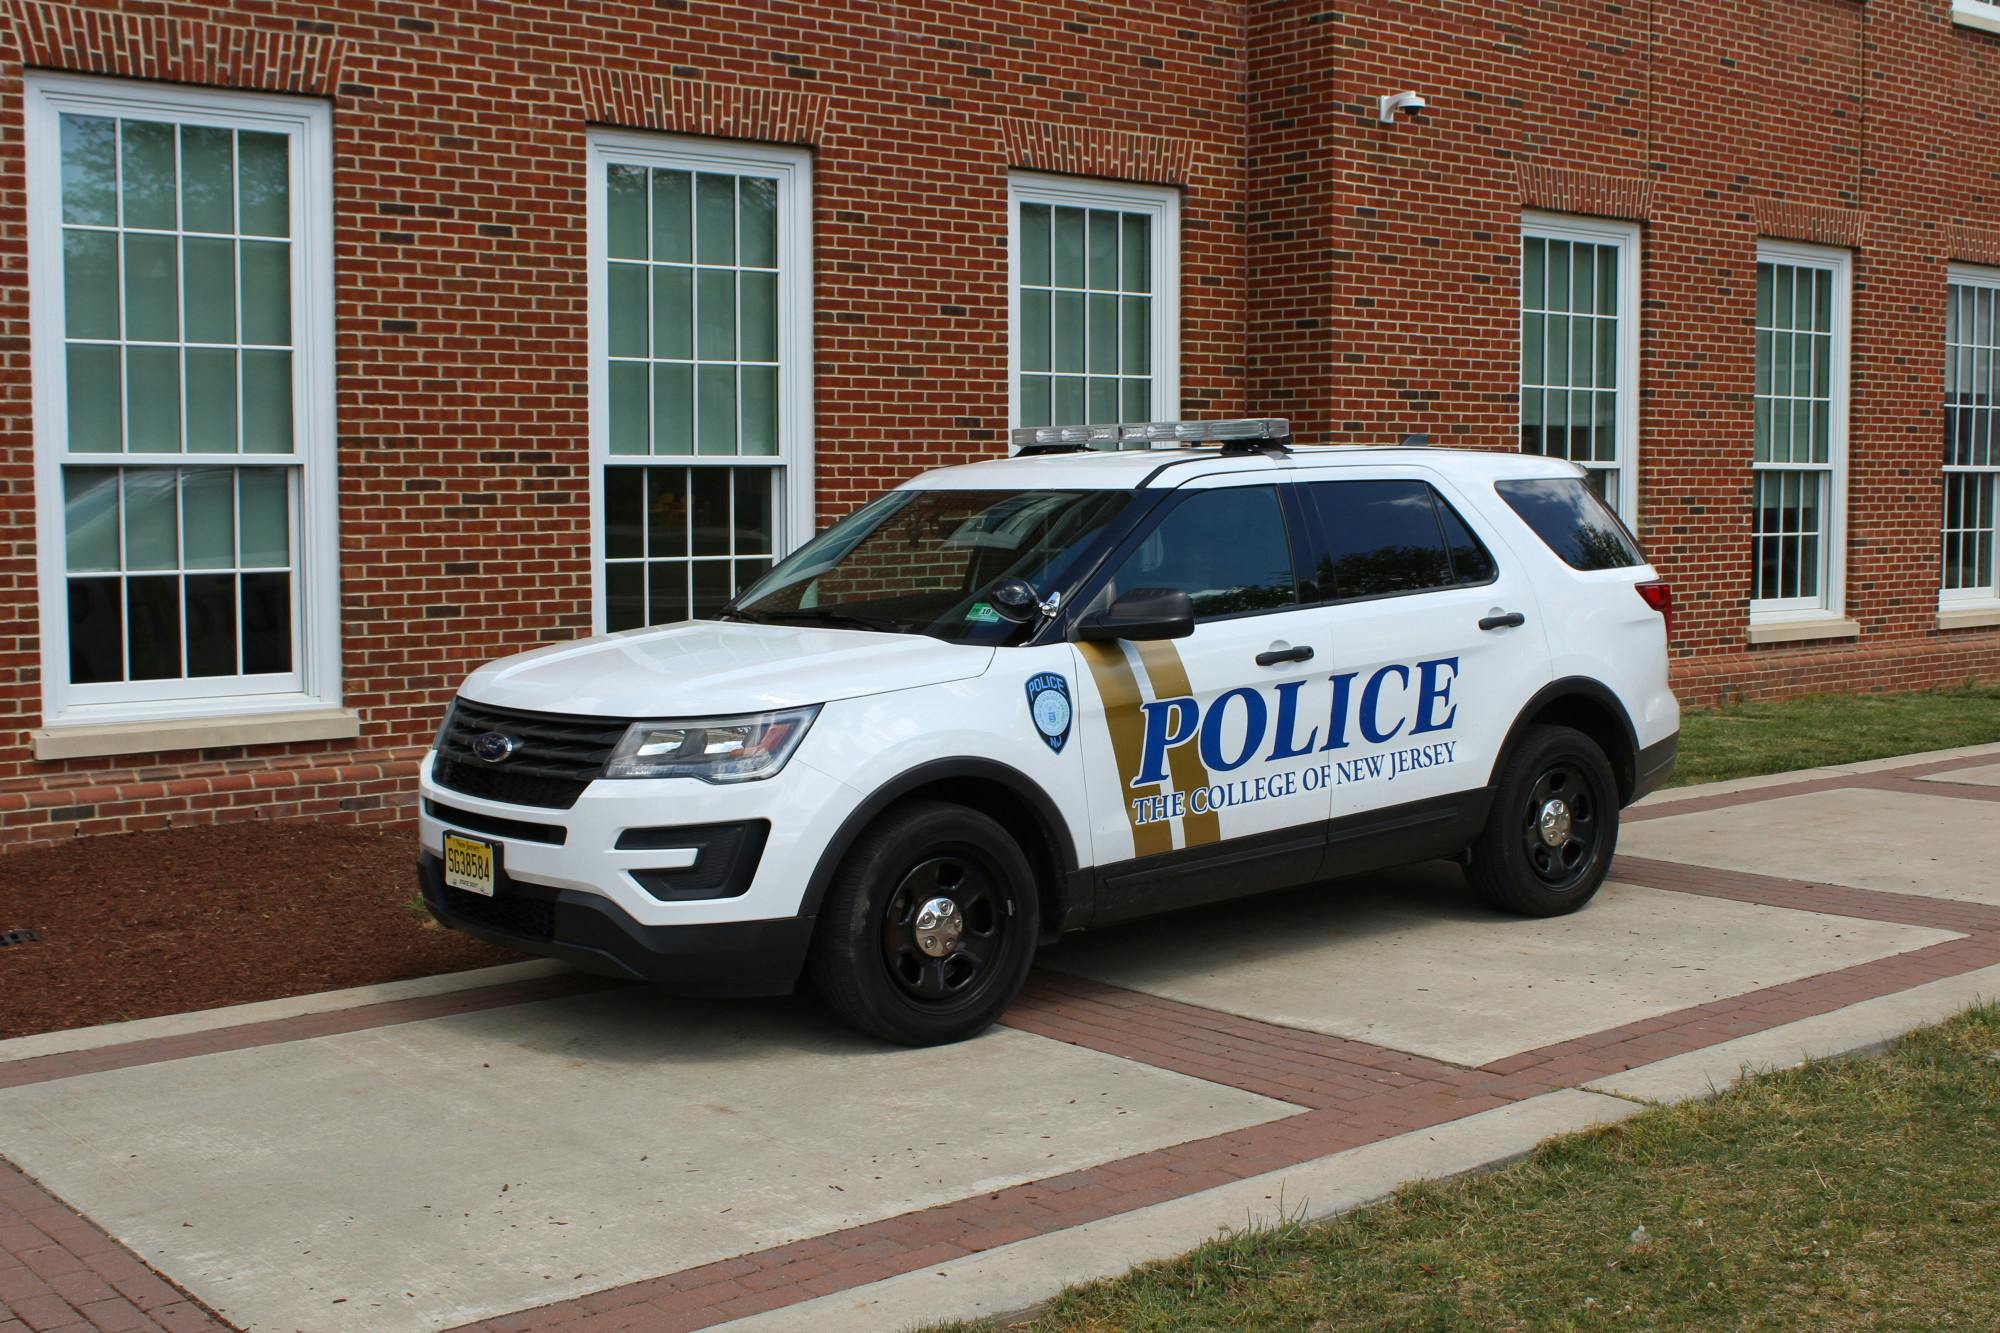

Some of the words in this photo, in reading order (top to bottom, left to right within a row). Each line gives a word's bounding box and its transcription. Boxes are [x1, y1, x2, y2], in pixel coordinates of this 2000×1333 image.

[1028, 675, 1067, 702] POLICE
[1132, 656, 1459, 787] POLICE
[1049, 735, 1062, 749] NJ
[1133, 791, 1185, 824] THE
[1191, 771, 1297, 815] COLLEGE
[1302, 765, 1331, 791] OF
[1336, 754, 1385, 785] NEW
[1388, 740, 1457, 780] JERSEY
[448, 847, 490, 882] SG38584
